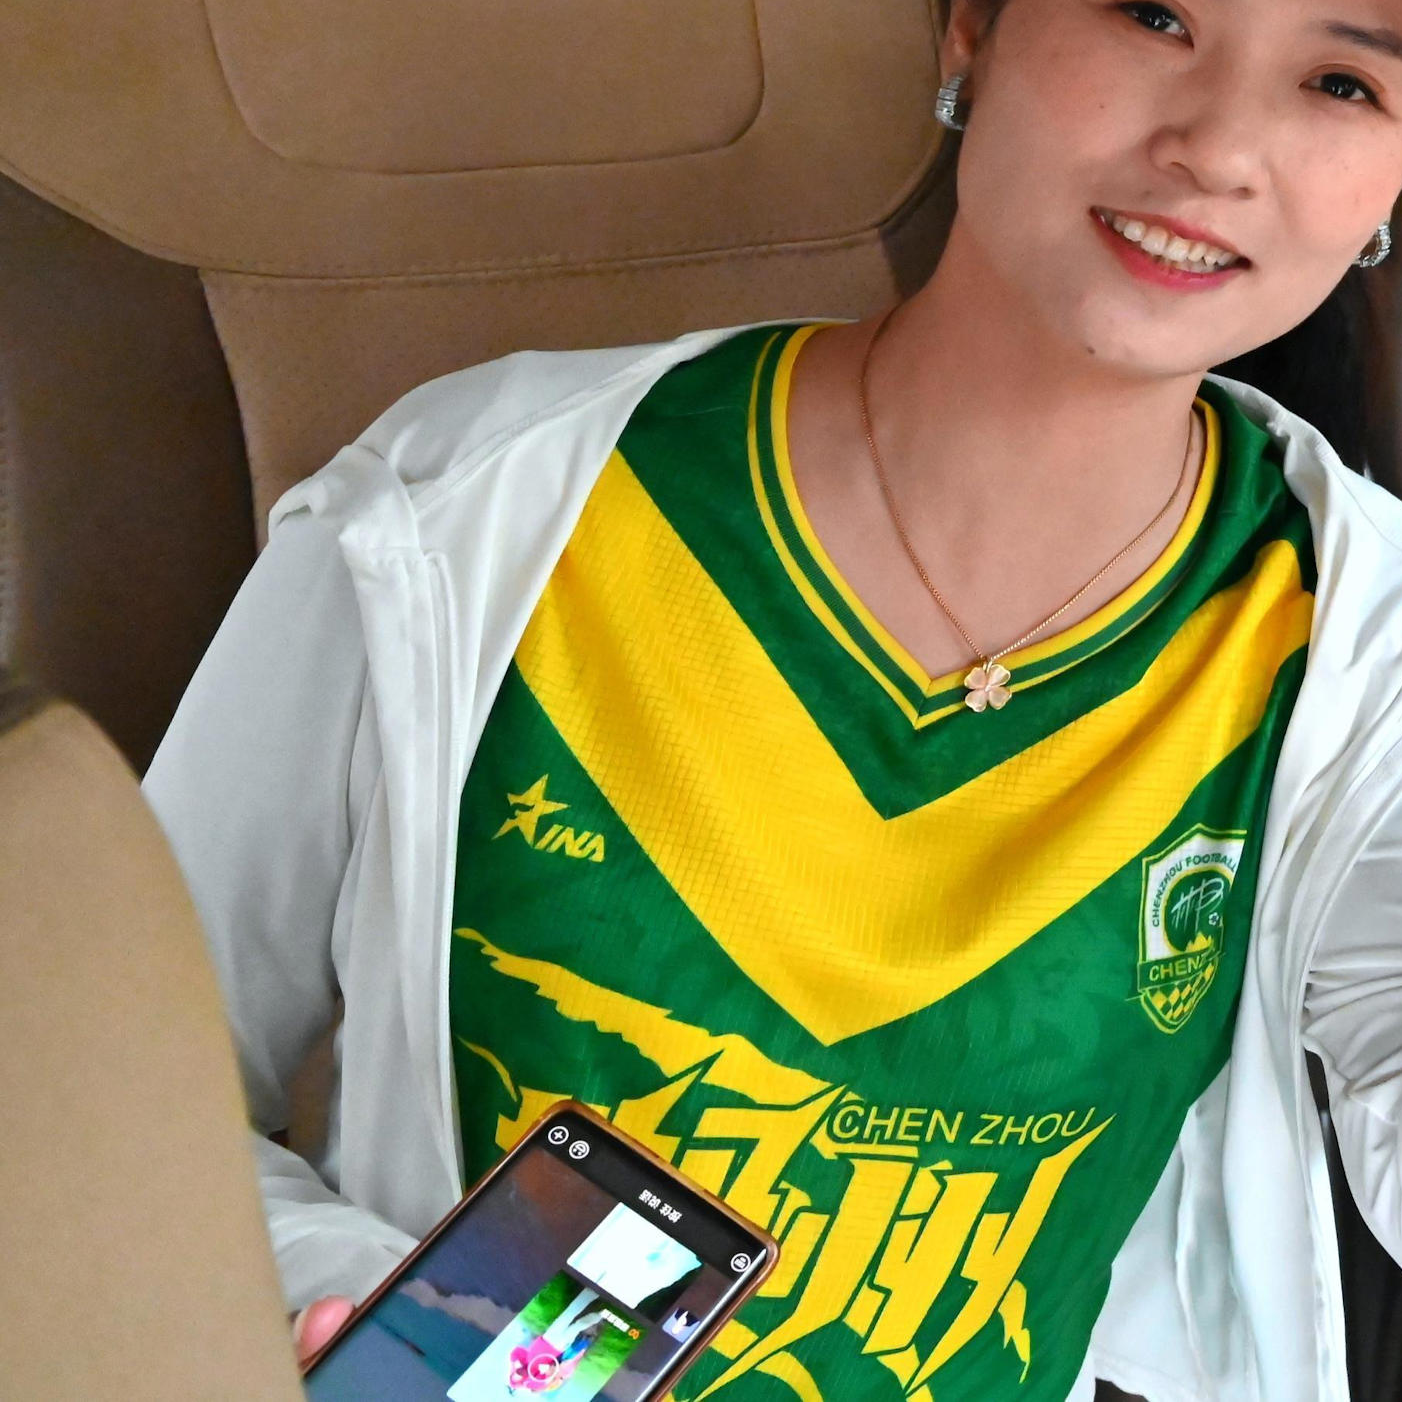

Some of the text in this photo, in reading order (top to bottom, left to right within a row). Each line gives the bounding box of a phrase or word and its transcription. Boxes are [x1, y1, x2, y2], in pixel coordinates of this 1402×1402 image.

[1152, 852, 1237, 928] CHENZHOU FOOTBALL
[832, 1104, 1097, 1145] CHEN ZHOU
